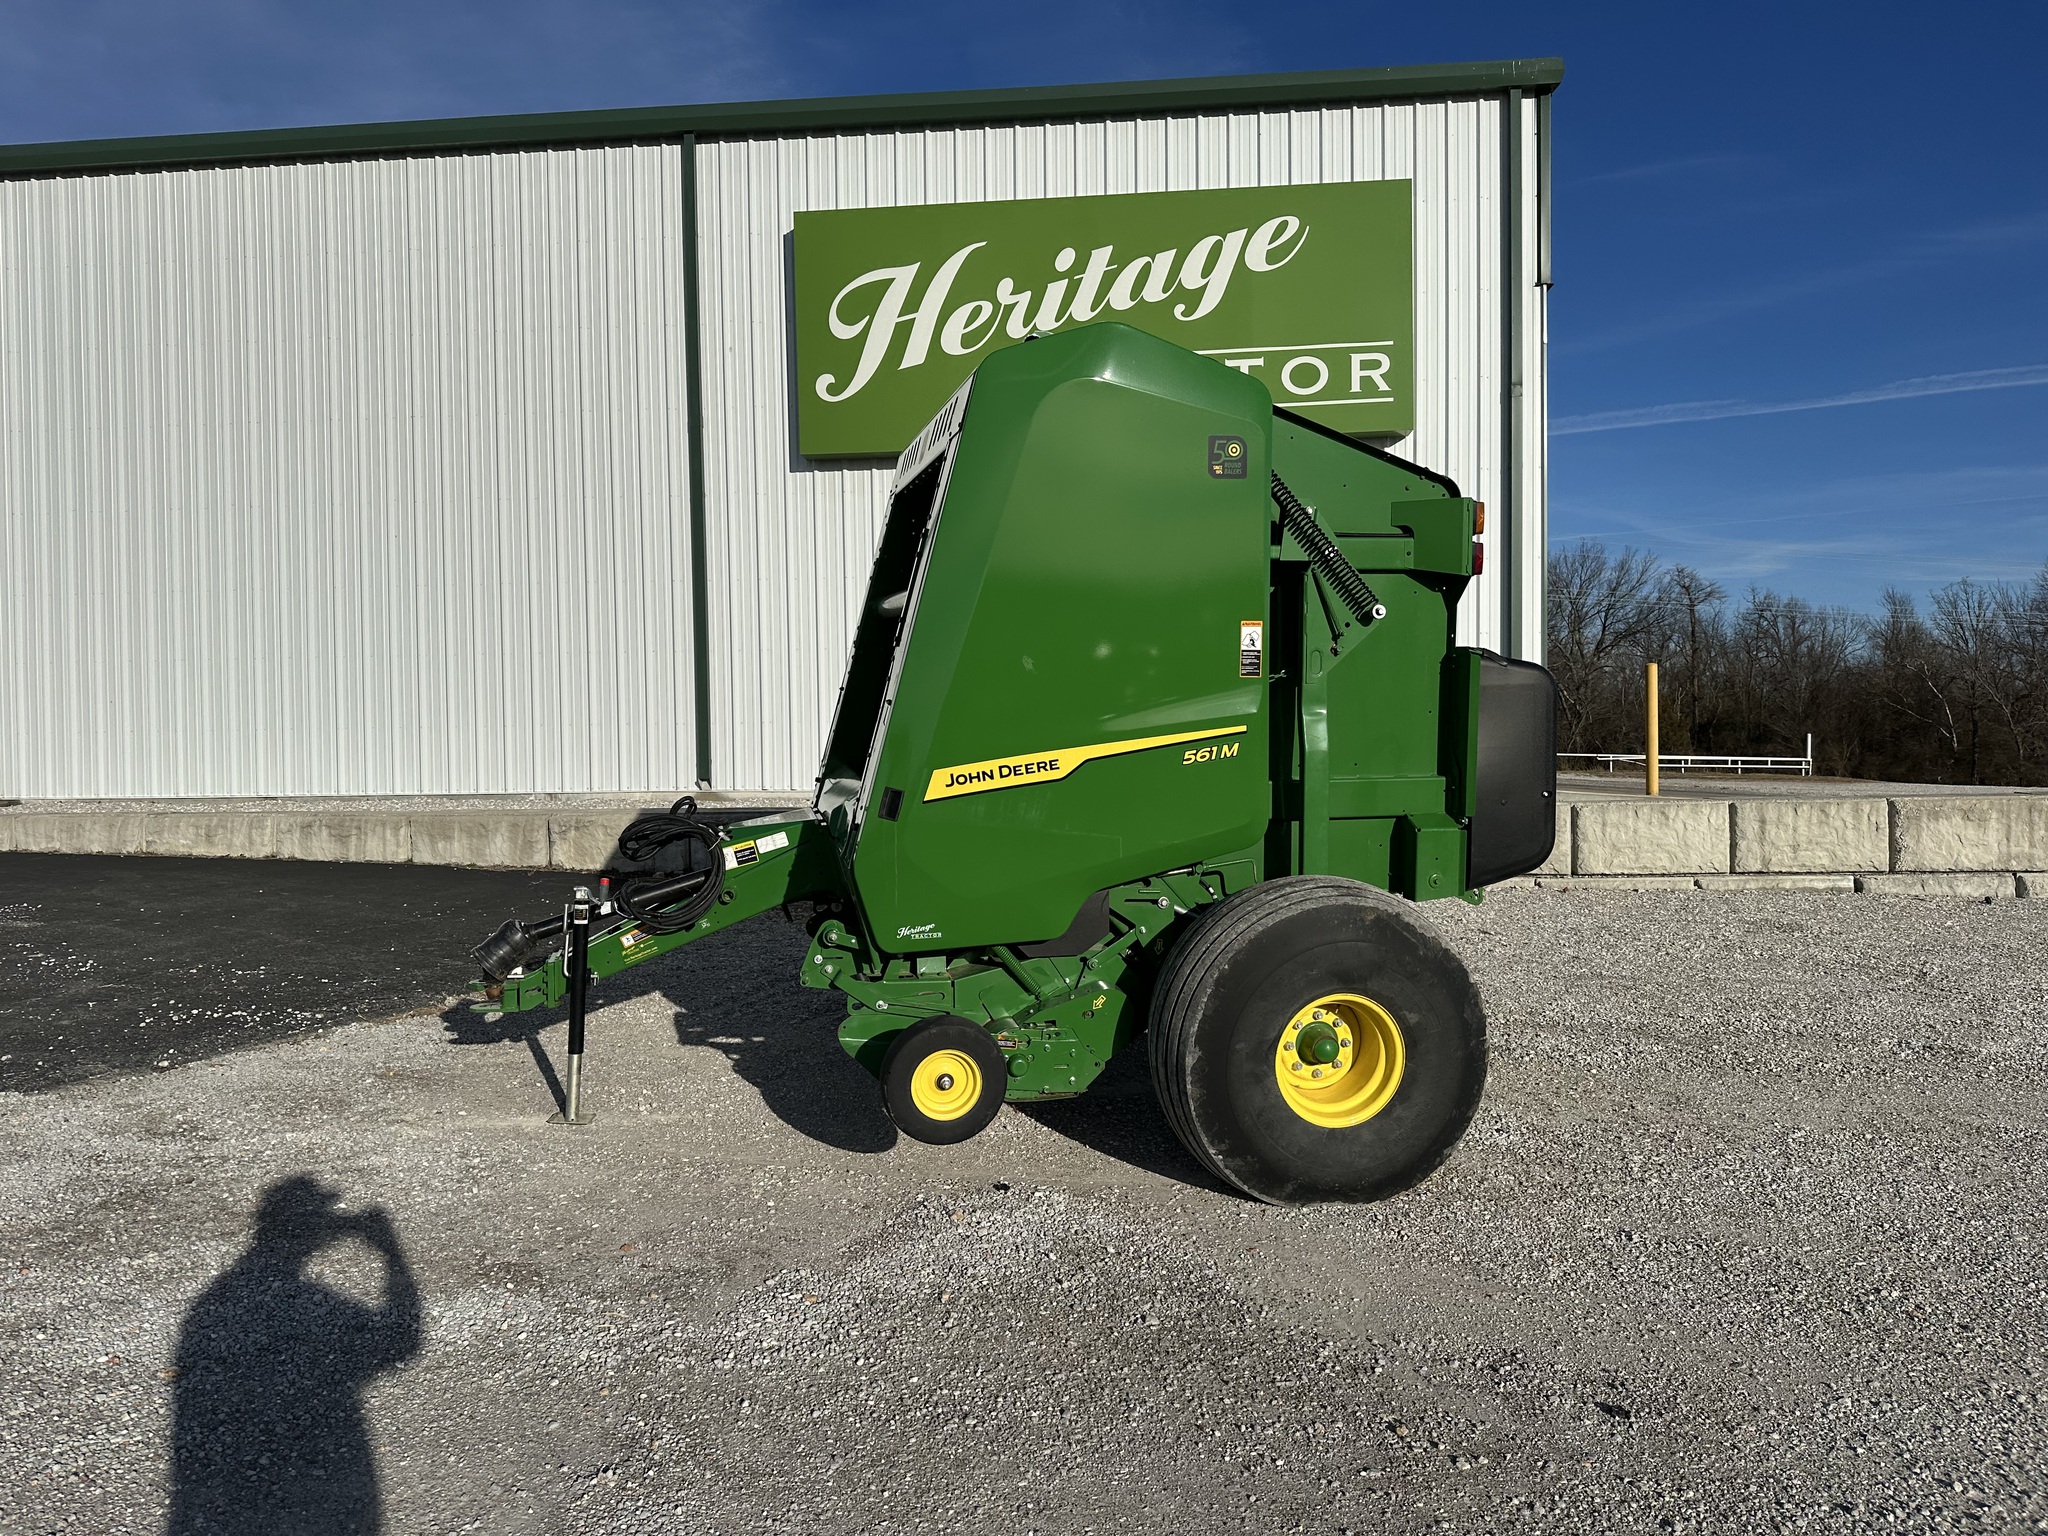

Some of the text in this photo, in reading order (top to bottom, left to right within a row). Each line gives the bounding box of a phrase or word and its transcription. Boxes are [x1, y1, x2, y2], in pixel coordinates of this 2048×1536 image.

[815, 215, 1309, 402] Heritage
[1182, 742, 1240, 766] 561 M
[896, 923, 935, 939] Heritage
[911, 932, 942, 940] TRACTOR
